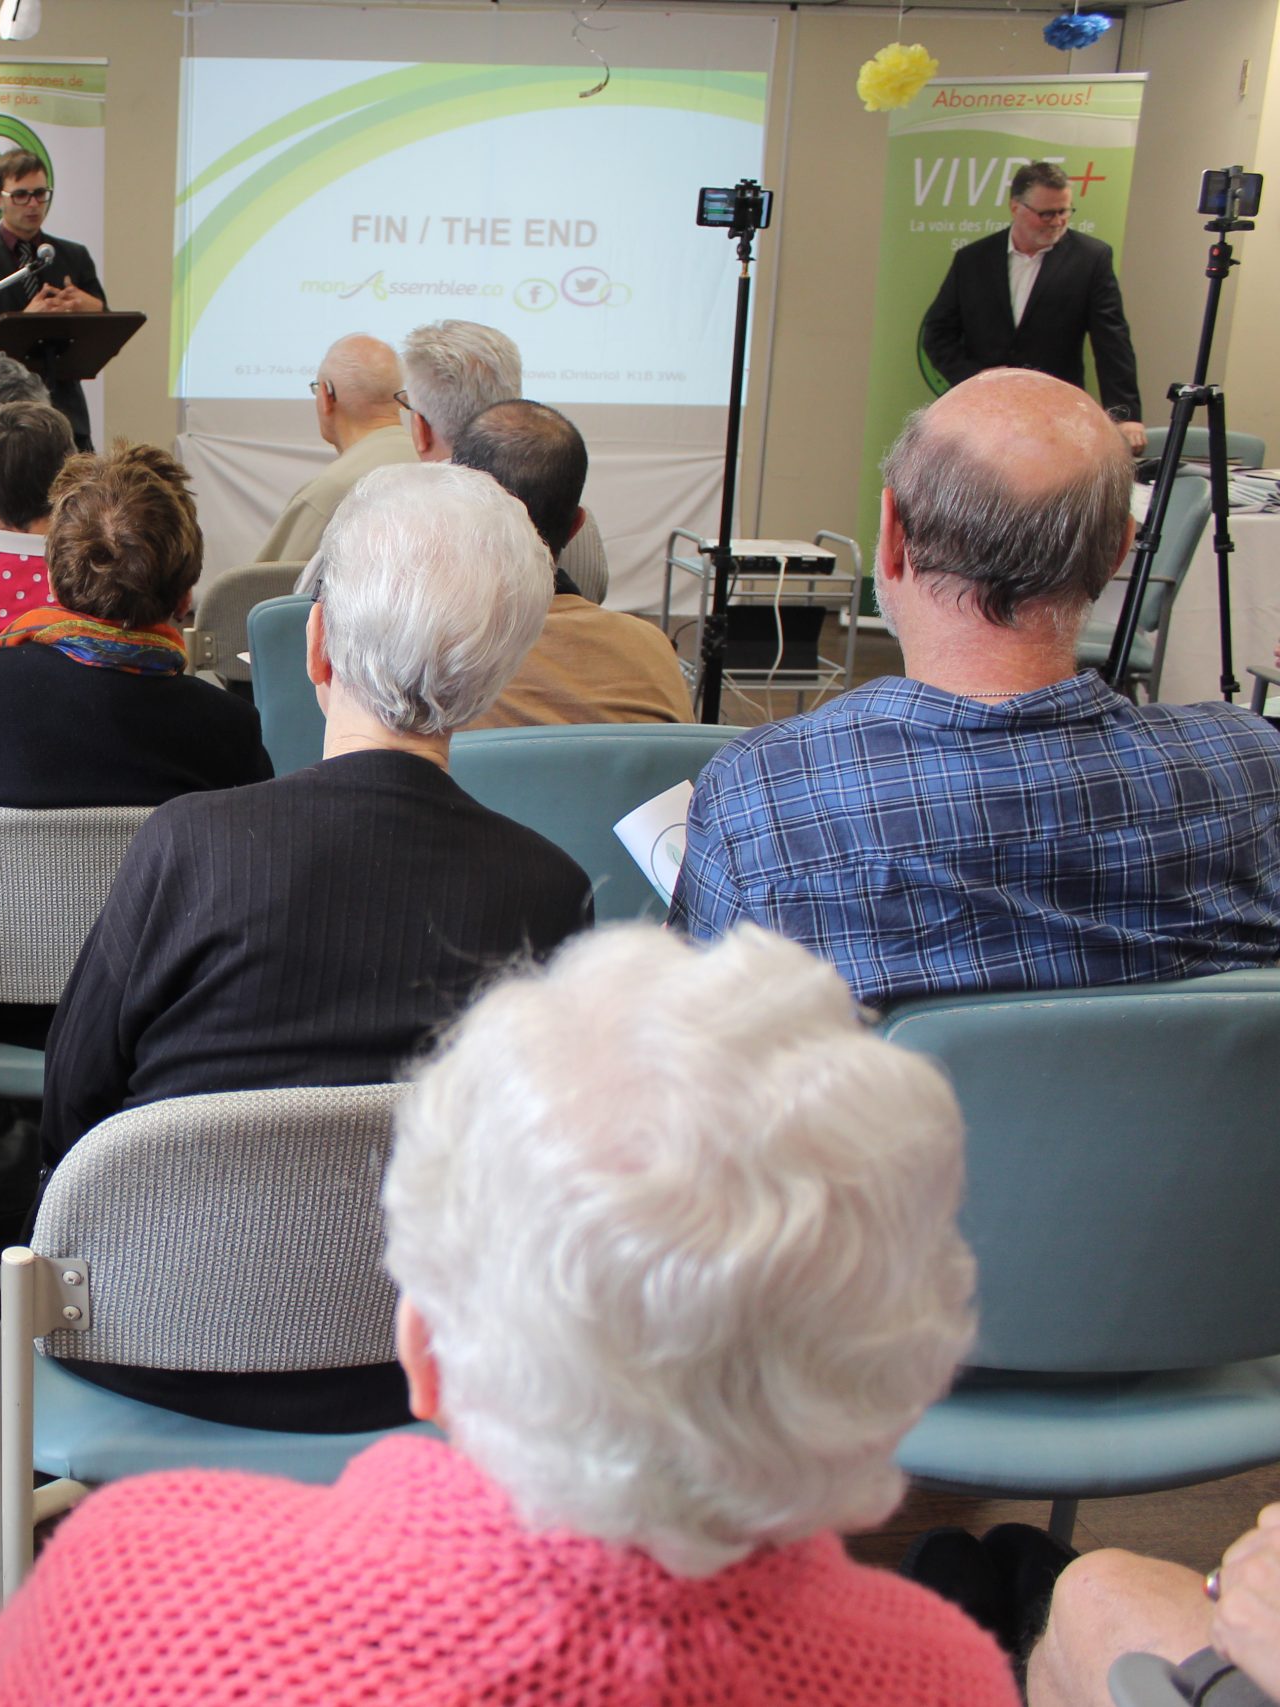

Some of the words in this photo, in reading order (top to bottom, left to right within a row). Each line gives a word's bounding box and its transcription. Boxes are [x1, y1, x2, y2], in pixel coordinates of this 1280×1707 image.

[68, 75, 83, 87] de
[0, 94, 11, 105] et
[932, 86, 1092, 109] Abonnez-vous!
[350, 214, 408, 245] FIN
[441, 216, 512, 246] THE
[523, 218, 598, 248] END
[909, 219, 925, 233] La
[928, 219, 954, 233] voix
[958, 219, 981, 233] des
[1078, 219, 1096, 233] de
